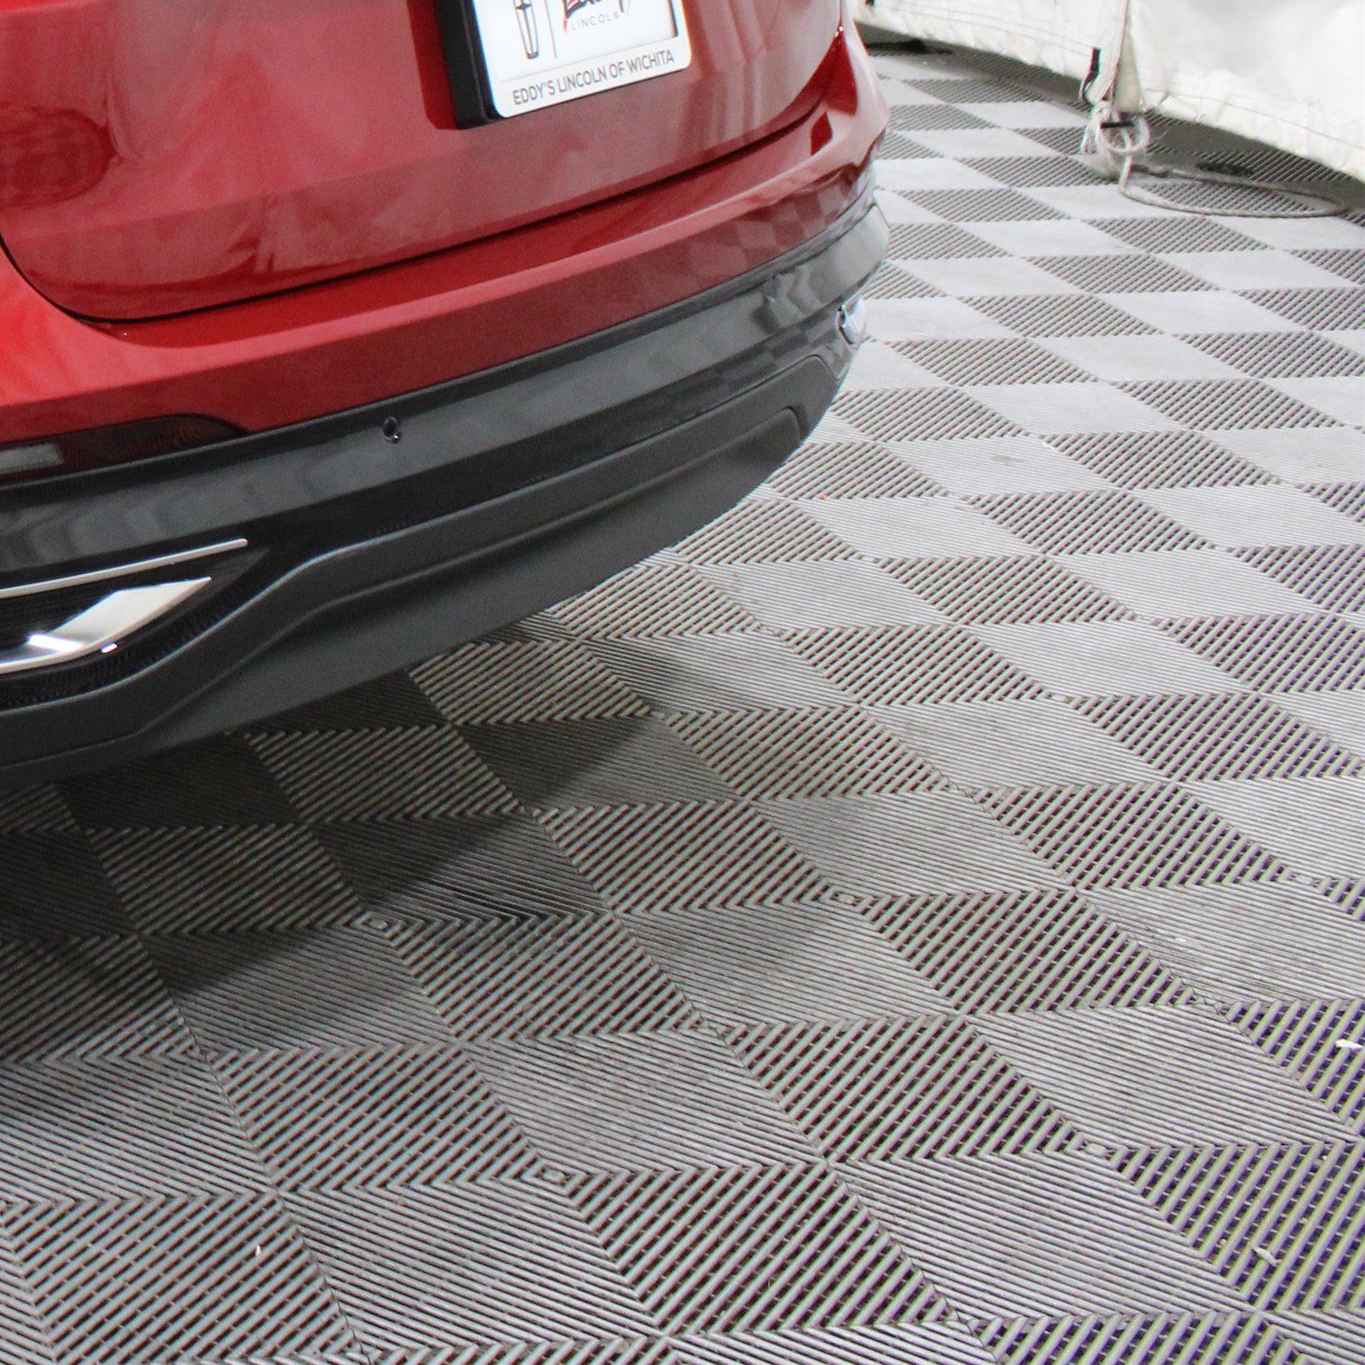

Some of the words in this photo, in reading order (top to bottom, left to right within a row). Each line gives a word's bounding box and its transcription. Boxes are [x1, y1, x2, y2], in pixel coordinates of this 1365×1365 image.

[570, 11, 620, 30] LINCOLN
[512, 80, 556, 105] EDDY'S
[556, 66, 607, 94] LINCOLN
[609, 61, 626, 79] OF
[626, 49, 675, 73] WICHITA
